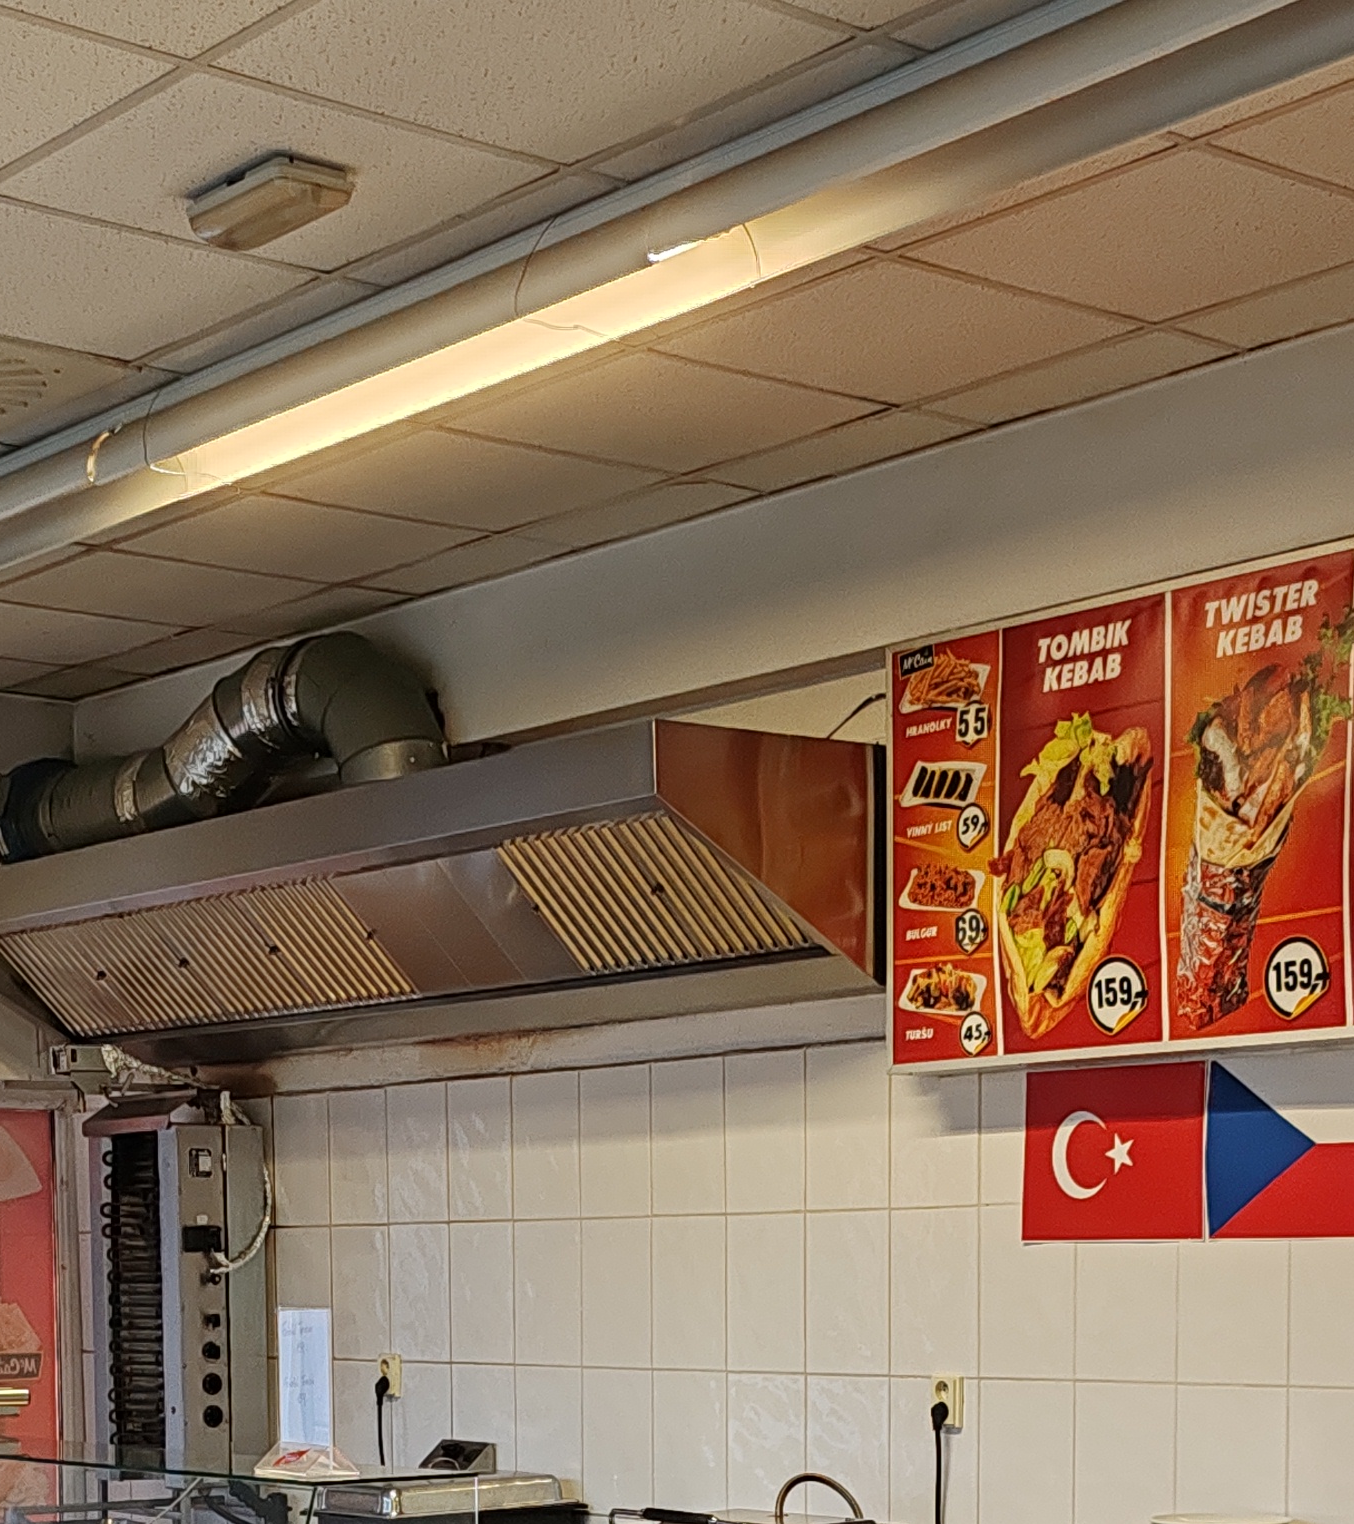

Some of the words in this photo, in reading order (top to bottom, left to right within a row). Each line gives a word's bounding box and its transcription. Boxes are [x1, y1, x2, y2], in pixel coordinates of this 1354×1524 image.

[1205, 579, 1319, 628] TWISTER
[1037, 619, 1131, 664] TOMBIK
[1216, 615, 1303, 659] KEBAB
[1042, 652, 1122, 693] KEBAB
[905, 717, 953, 738] HRANOLKY
[935, 820, 953, 834] LIST
[906, 926, 938, 941] BULGUR
